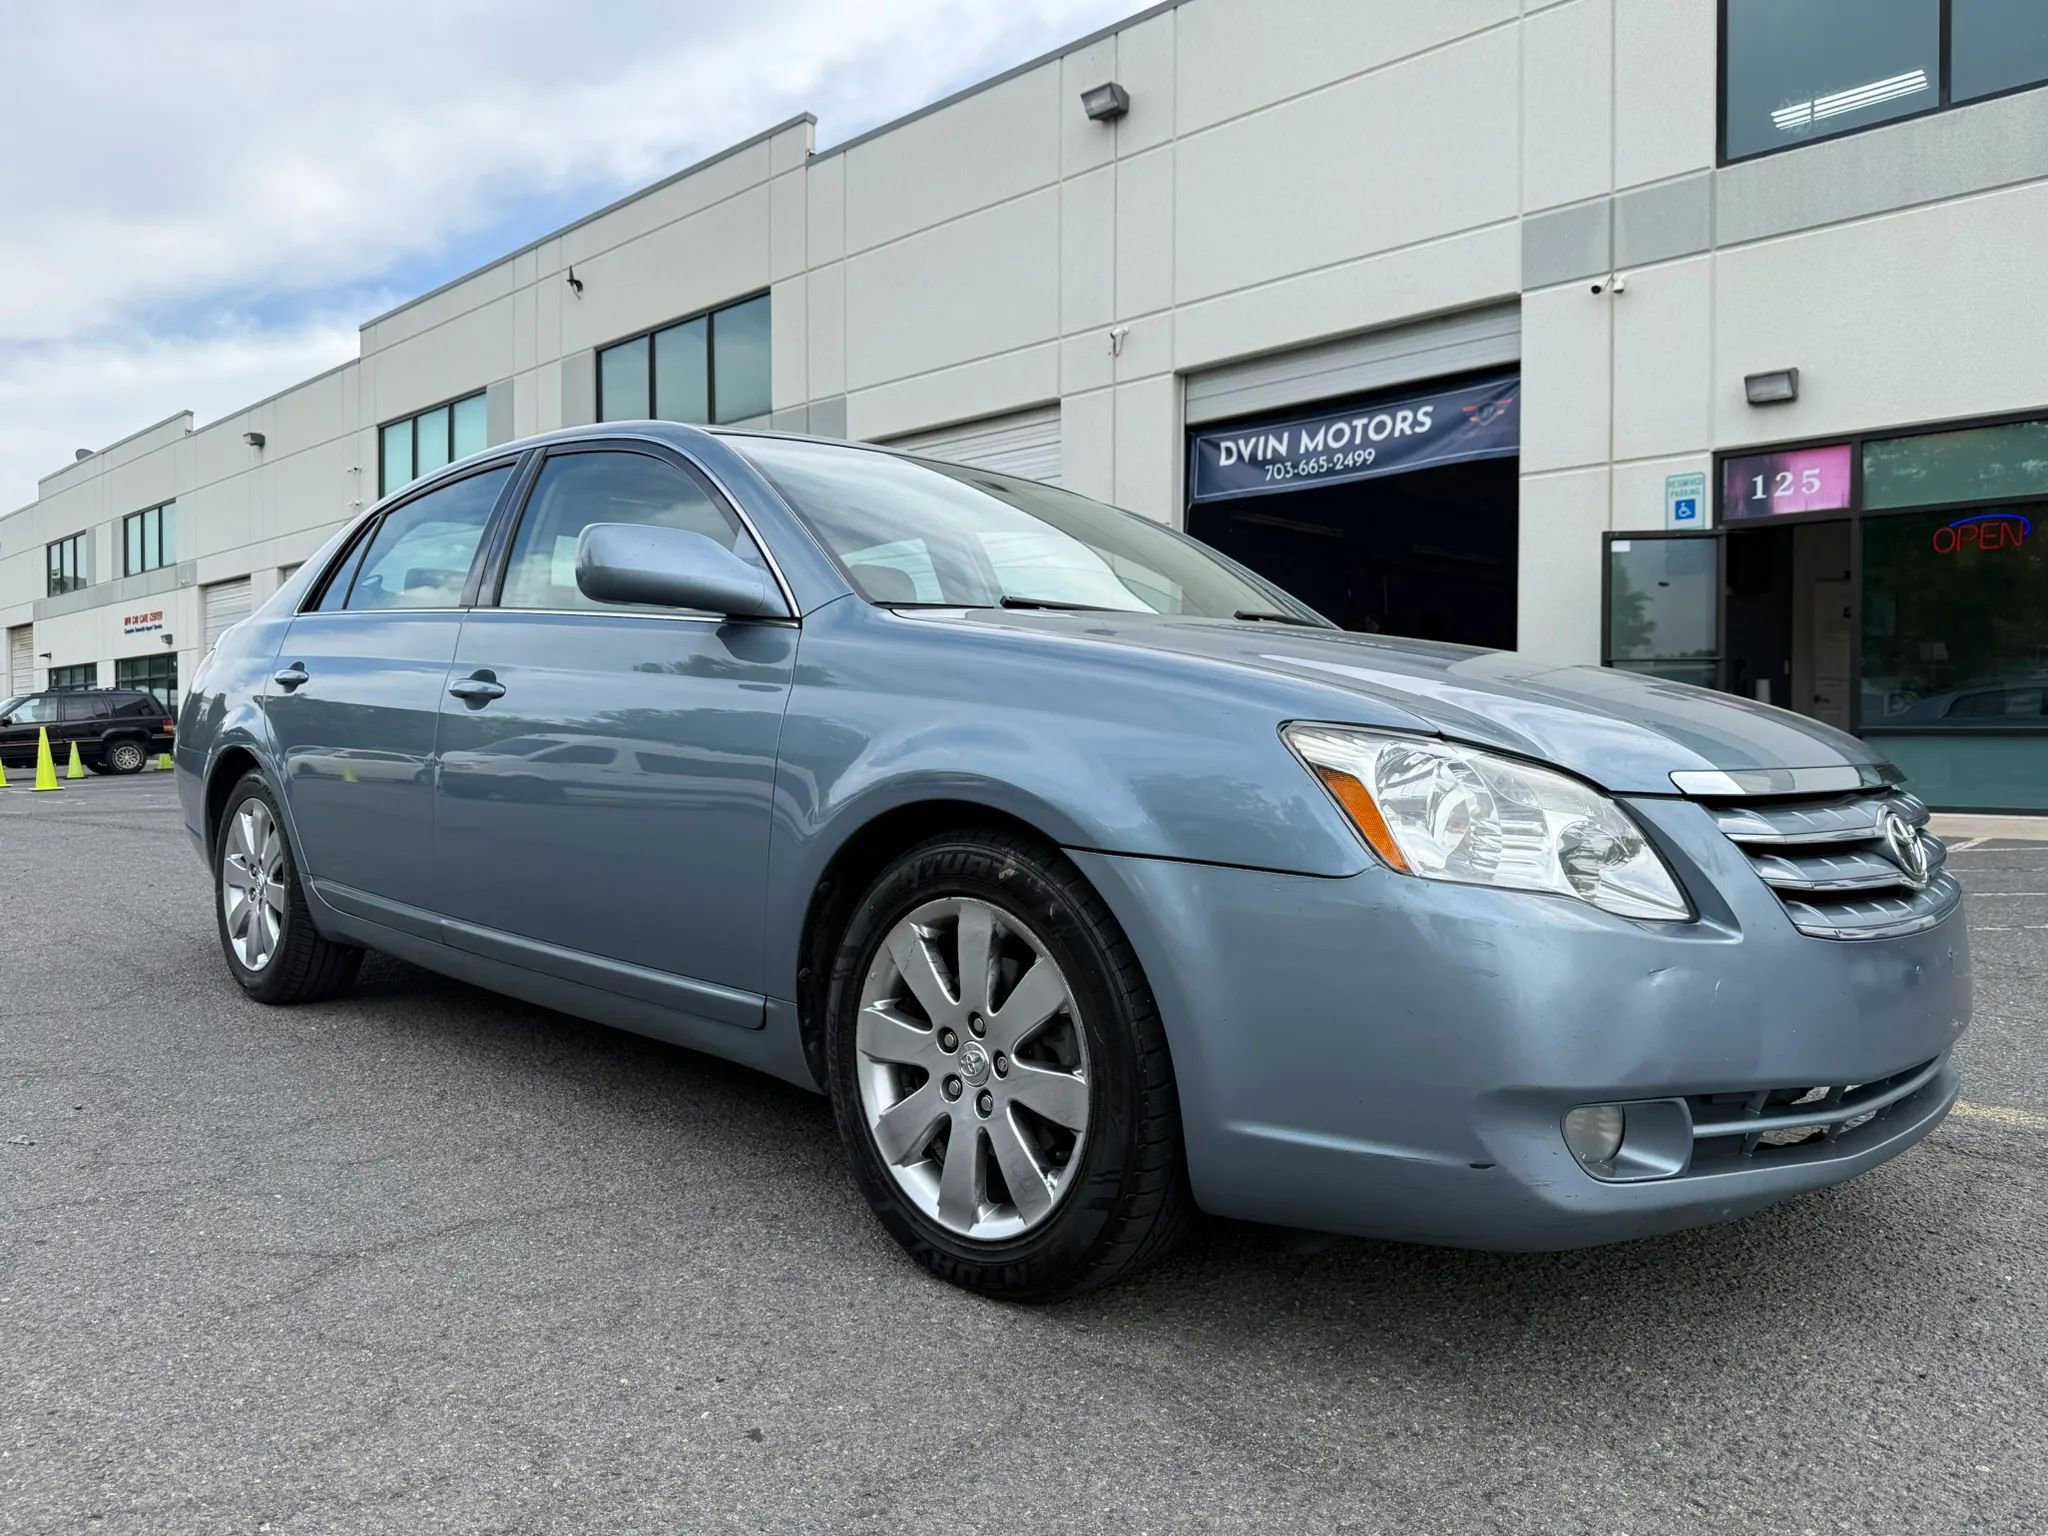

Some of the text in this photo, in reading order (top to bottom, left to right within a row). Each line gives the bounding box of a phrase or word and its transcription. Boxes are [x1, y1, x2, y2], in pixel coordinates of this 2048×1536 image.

[1219, 405, 1434, 466] DVIN MOTORS
[1264, 448, 1376, 481] 703-665-2499
[1751, 467, 1821, 500] 125
[1932, 520, 2025, 554] OPEN
